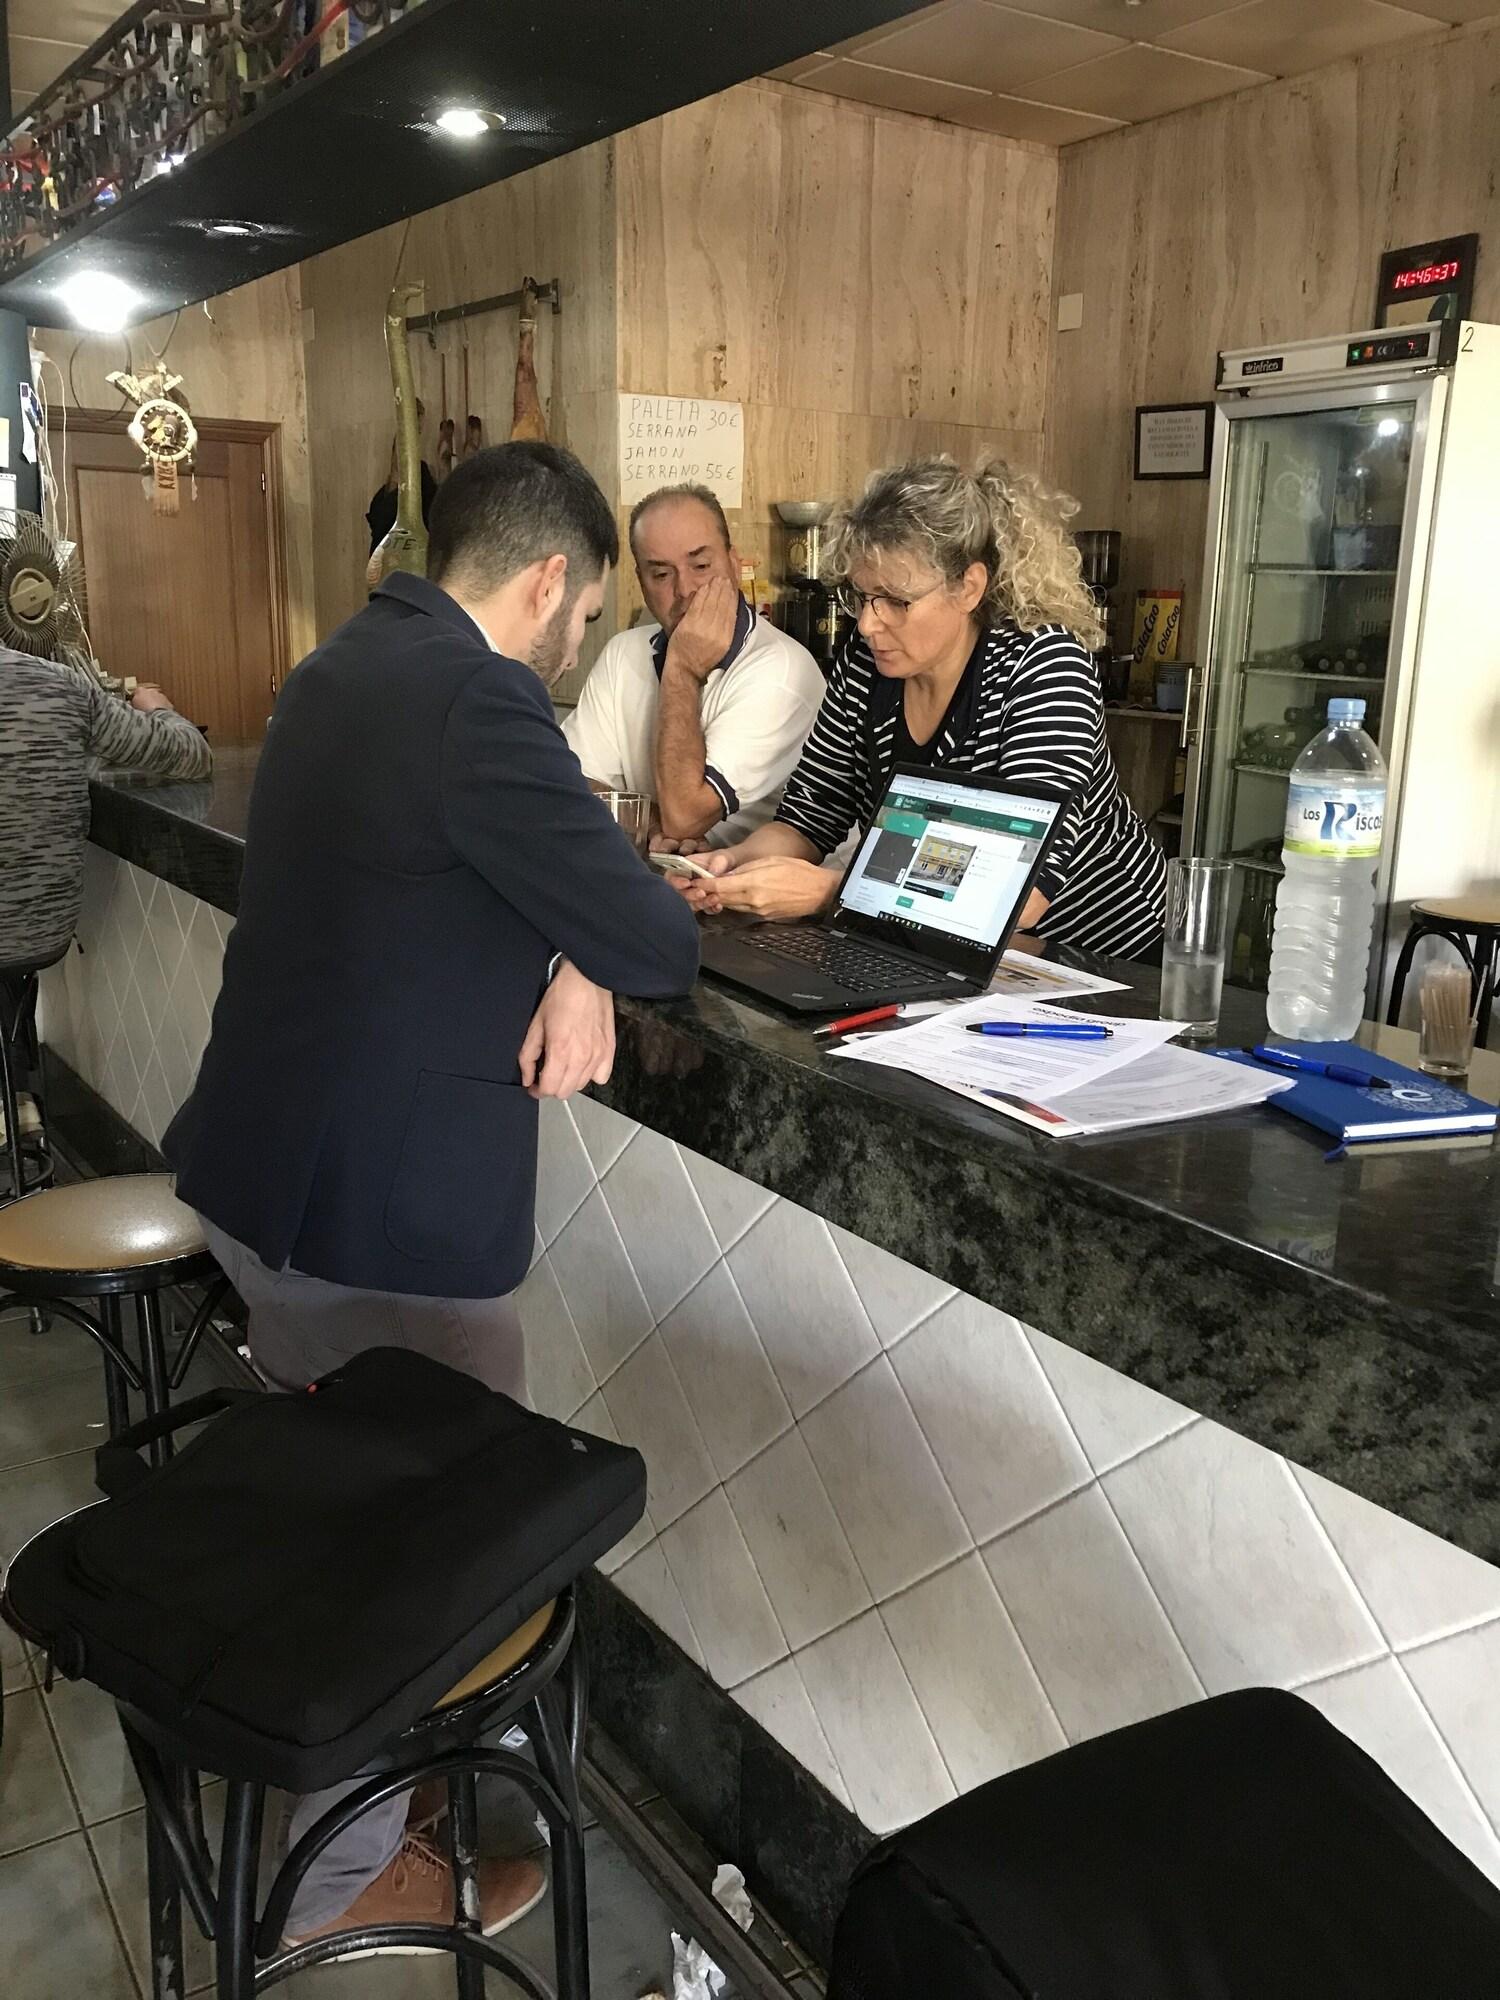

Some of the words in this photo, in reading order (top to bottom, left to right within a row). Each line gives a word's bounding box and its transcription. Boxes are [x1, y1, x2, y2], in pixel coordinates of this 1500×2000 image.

[1394, 261, 1459, 289] 14:46:37
[1461, 326, 1474, 352] 2
[631, 398, 700, 421] PALETA
[707, 409, 739, 431] 30€
[628, 422, 697, 438] SERRANA
[624, 446, 684, 460] JAMON
[624, 464, 700, 480] SERRANO
[706, 463, 736, 480] 55€
